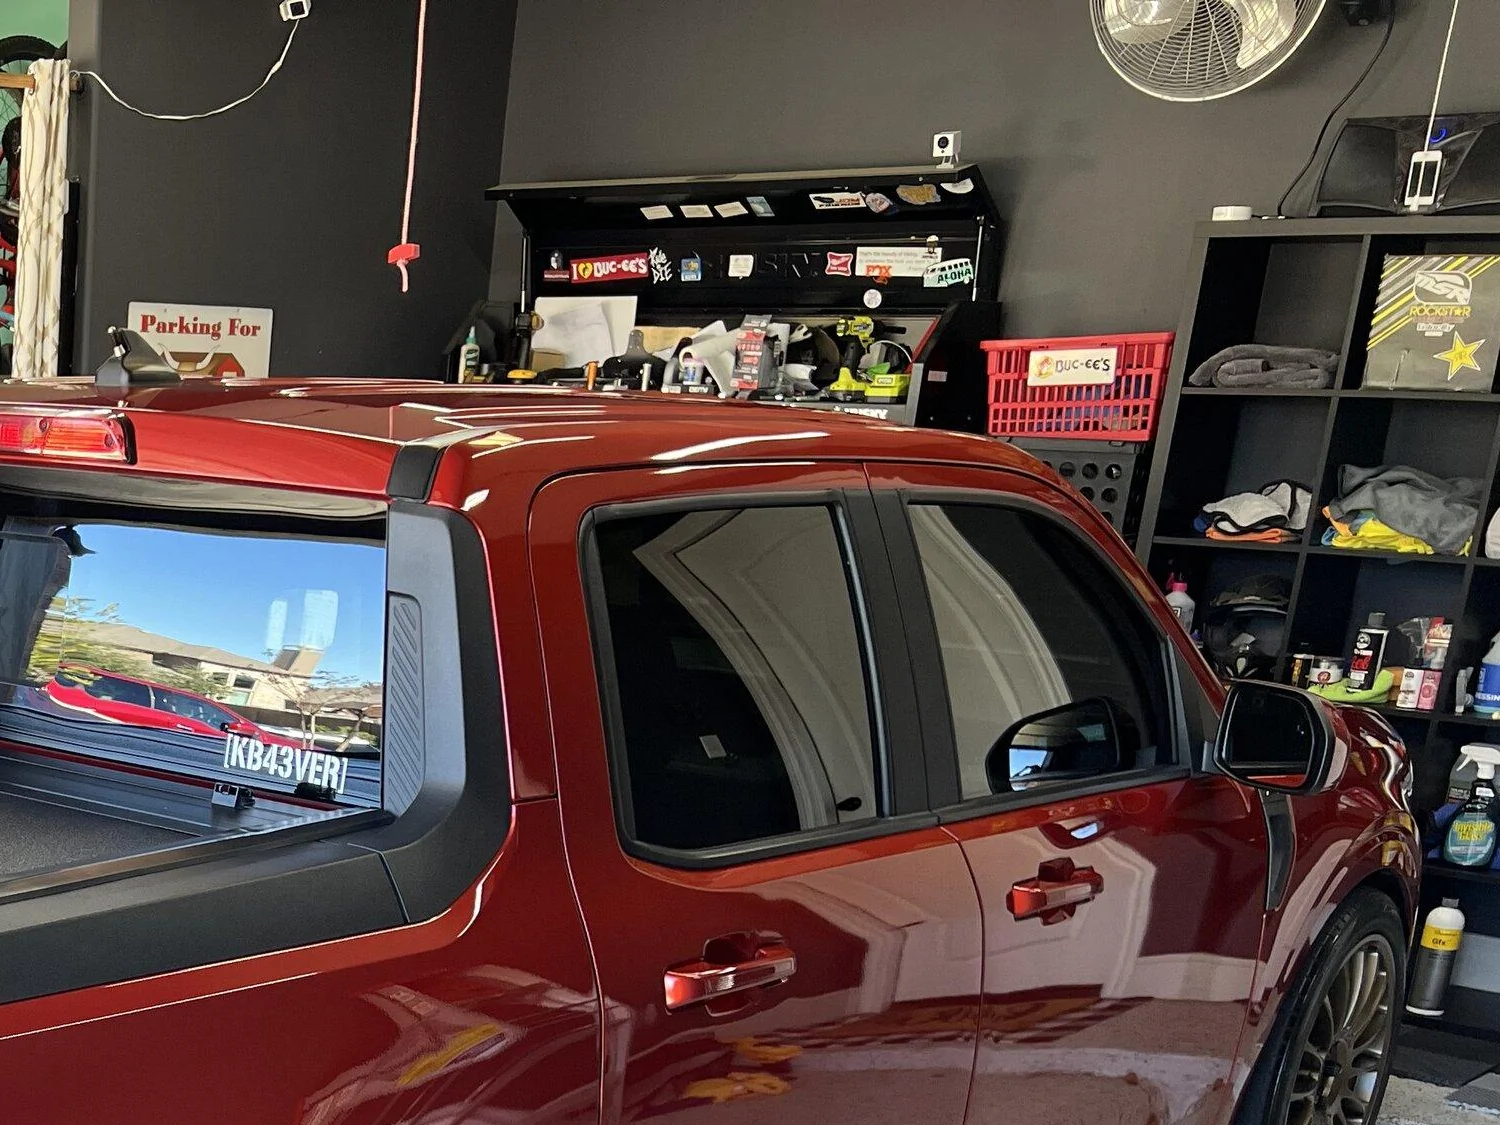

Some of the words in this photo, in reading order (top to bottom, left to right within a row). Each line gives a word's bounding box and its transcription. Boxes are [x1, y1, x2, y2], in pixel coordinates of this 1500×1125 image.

[937, 268, 973, 284] ALOHA
[140, 314, 222, 341] Parking
[228, 318, 261, 337] For
[1055, 358, 1111, 373] BUC-EE'S
